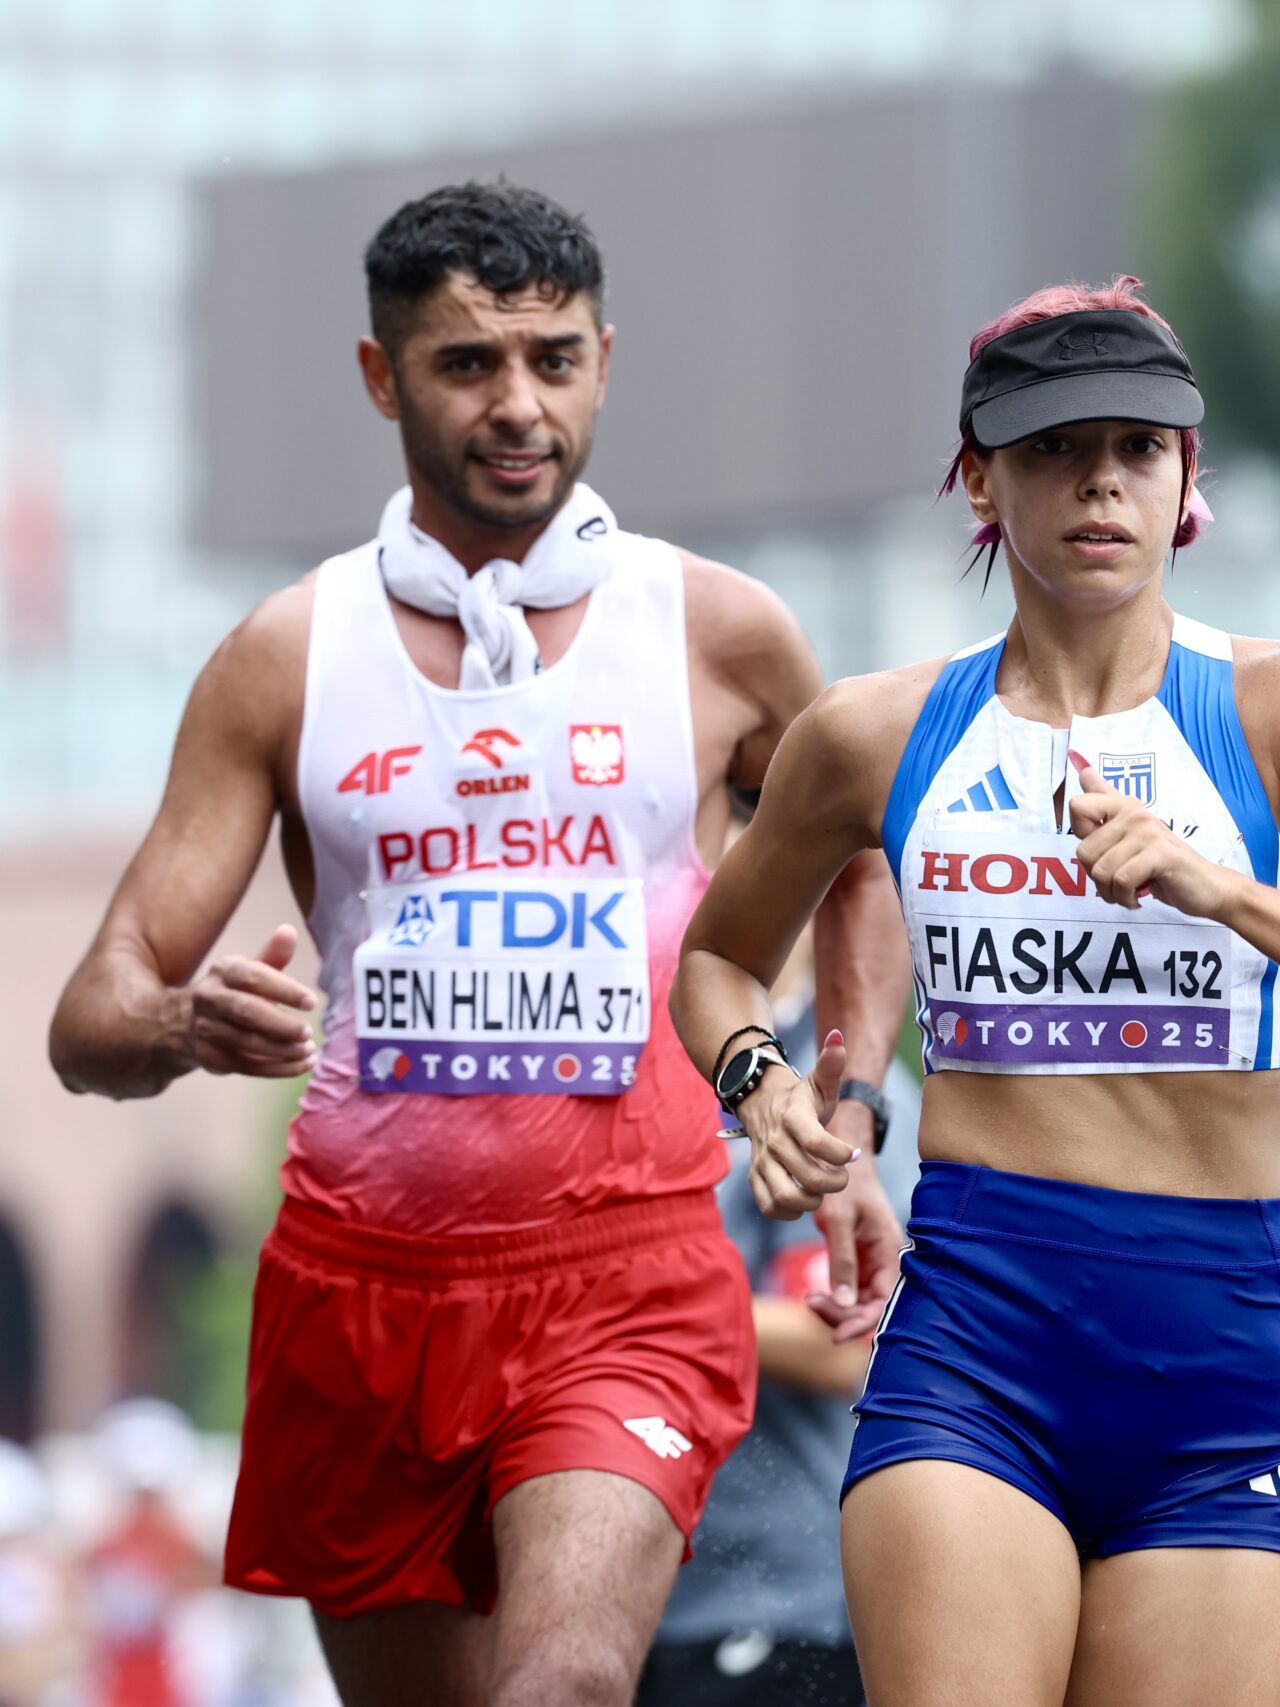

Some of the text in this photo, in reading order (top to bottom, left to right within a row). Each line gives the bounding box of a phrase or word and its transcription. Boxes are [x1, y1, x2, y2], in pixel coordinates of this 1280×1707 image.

[456, 774, 530, 798] ORLEN
[377, 814, 616, 881] POLSKA
[917, 850, 1151, 900] HON
[440, 890, 628, 950] TDK
[924, 924, 1223, 1000] FIASKA 132
[364, 967, 436, 1031] BEN
[450, 970, 584, 1032] HLIMA
[1161, 1021, 1215, 1049] 25
